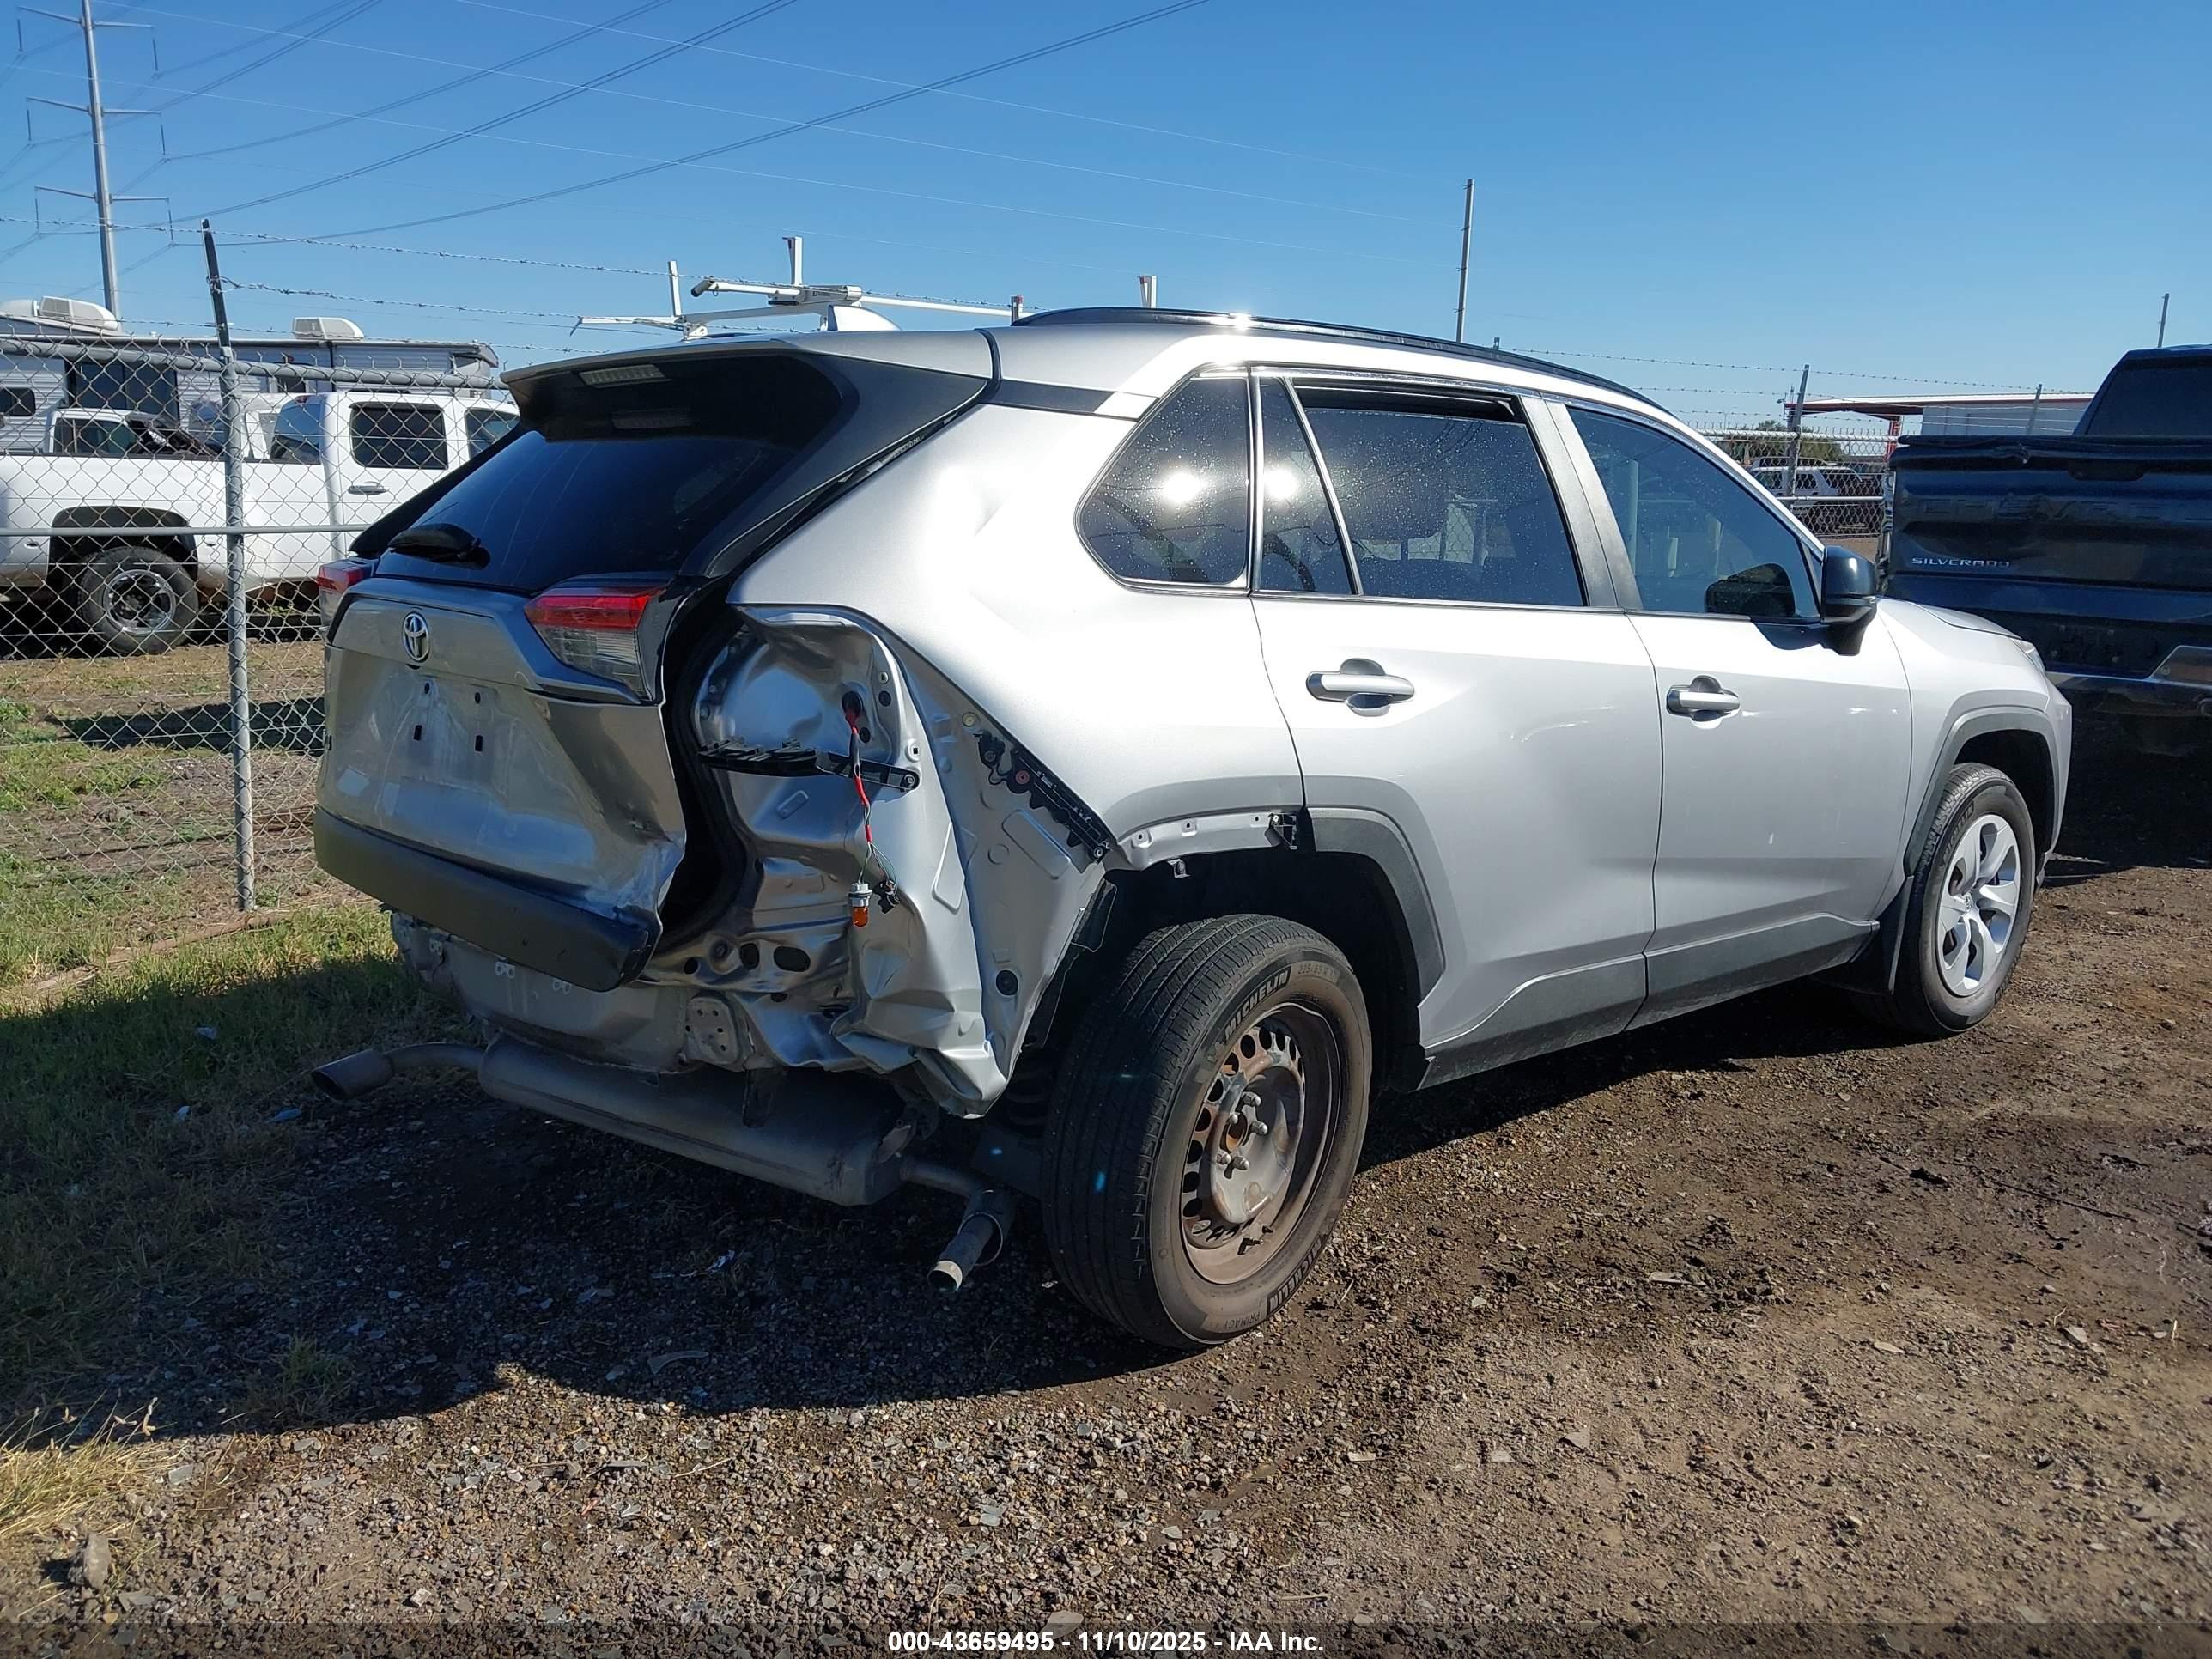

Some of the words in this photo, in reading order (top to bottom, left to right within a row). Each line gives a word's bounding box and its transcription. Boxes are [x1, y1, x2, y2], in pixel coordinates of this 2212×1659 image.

[1911, 557, 2010, 568] SILVERADO
[1224, 969, 1288, 1041] MICHELIN
[1269, 1237, 1322, 1312] MICHELIN
